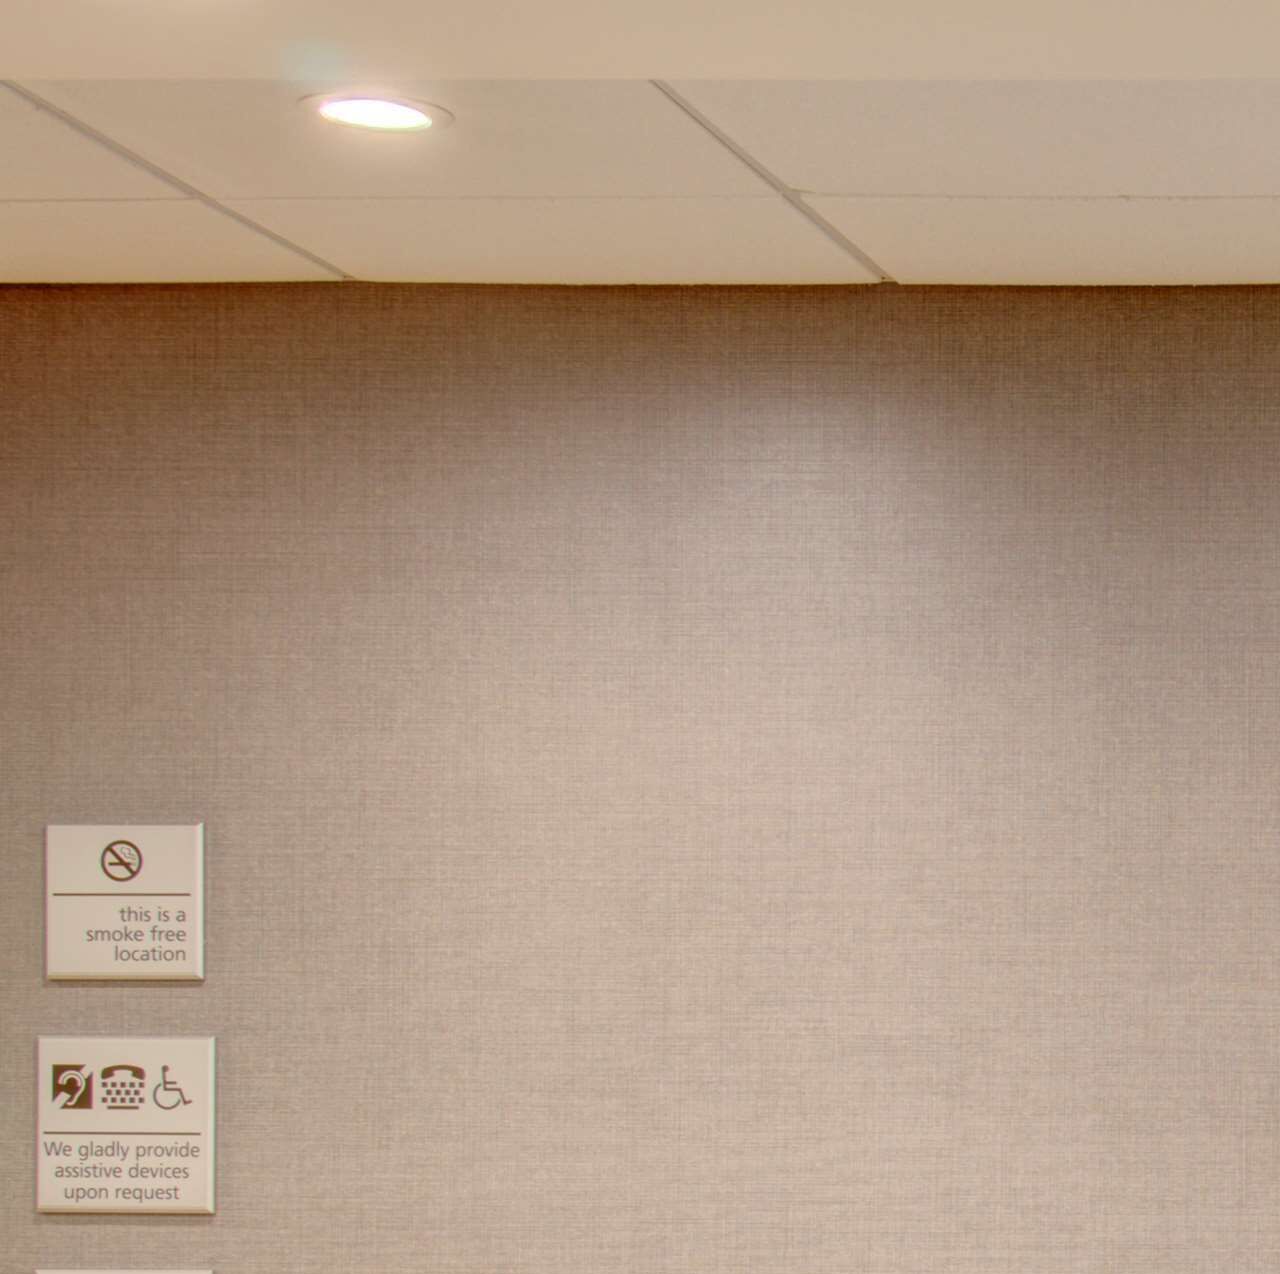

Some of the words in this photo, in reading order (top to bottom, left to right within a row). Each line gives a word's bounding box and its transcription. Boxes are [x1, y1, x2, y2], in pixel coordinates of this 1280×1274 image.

[119, 906, 152, 923] this
[157, 907, 171, 923] is
[175, 910, 187, 923] a
[86, 925, 145, 943] smoke
[150, 925, 187, 943] free
[114, 945, 187, 962] location
[43, 1141, 73, 1158] We
[78, 1140, 130, 1164] gladly
[135, 1141, 200, 1163] provide
[54, 1163, 123, 1179] assistive
[128, 1163, 190, 1179] devices
[64, 1187, 109, 1203] upon
[115, 1186, 180, 1204] request
